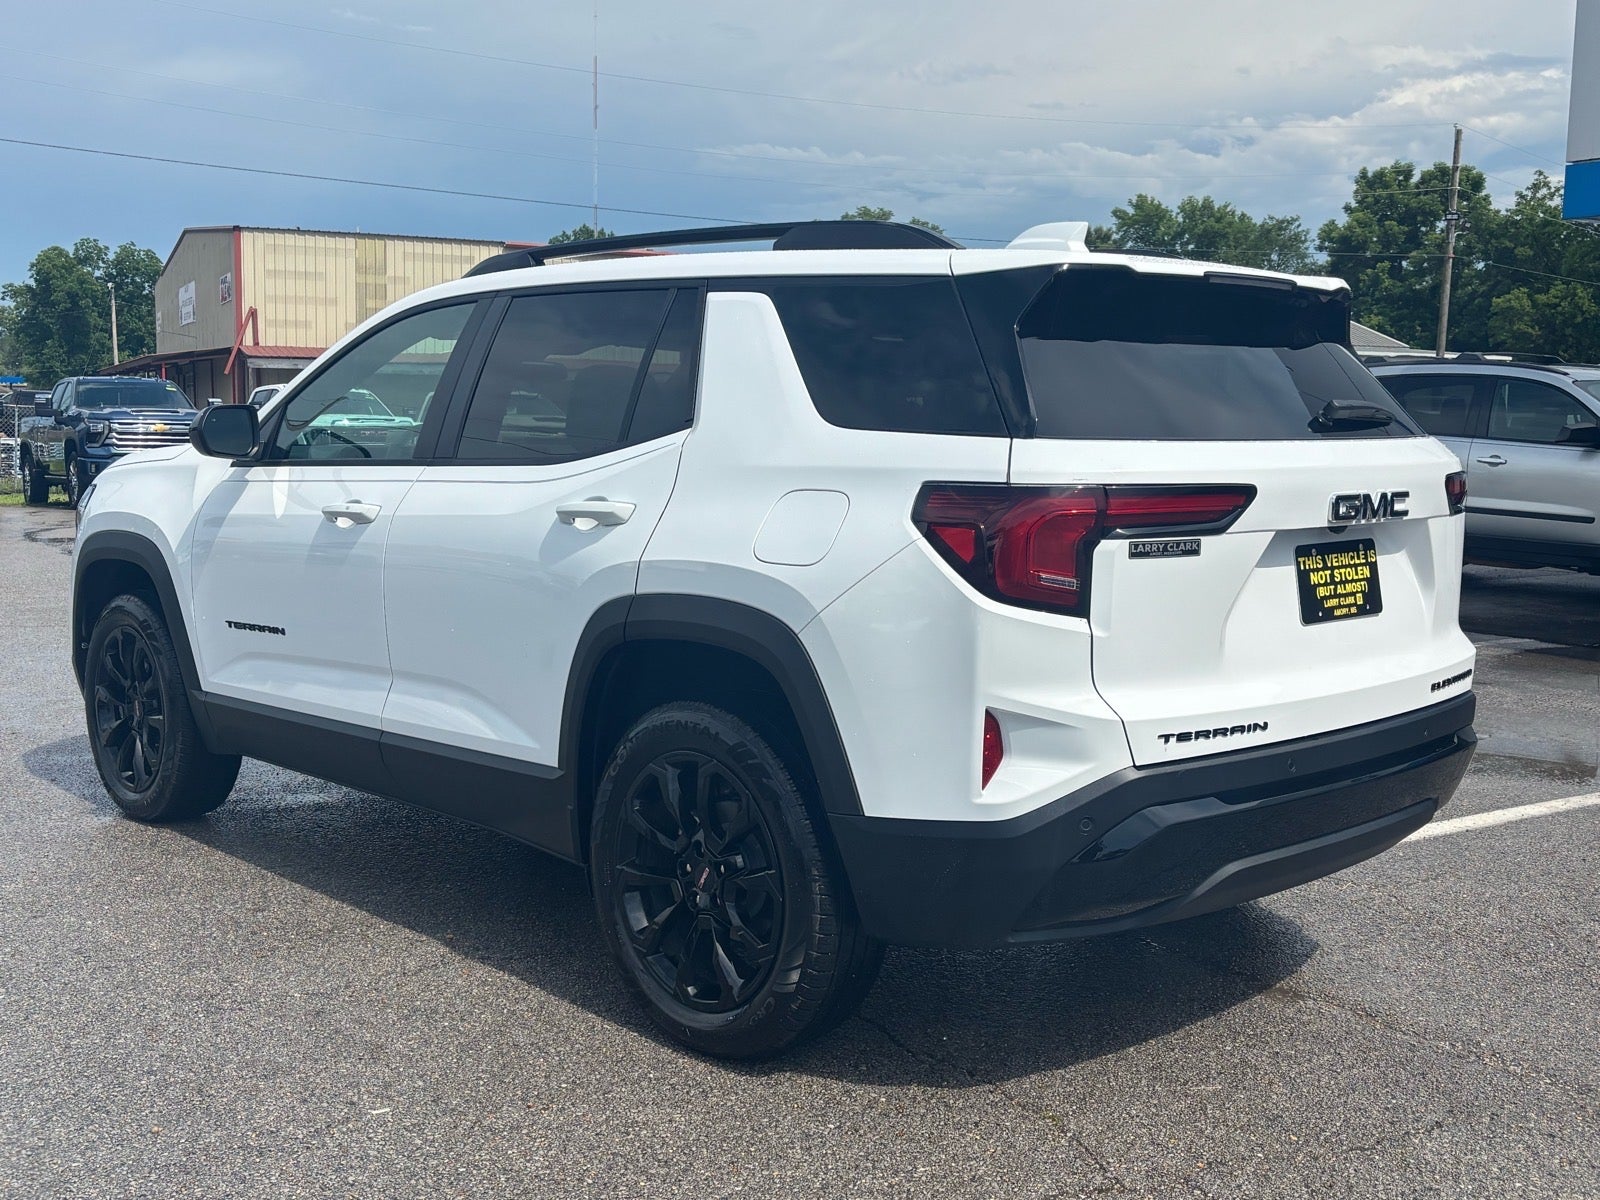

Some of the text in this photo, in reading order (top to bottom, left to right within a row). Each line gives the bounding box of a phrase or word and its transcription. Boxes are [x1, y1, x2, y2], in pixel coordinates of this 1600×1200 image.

[1329, 491, 1410, 523] GMC
[1131, 543, 1165, 553] LARRY
[1167, 541, 1199, 551] CLARK
[1297, 549, 1376, 570] THIS VEHICLE IS
[1310, 565, 1371, 585] NOT STOLEN
[1316, 581, 1368, 599] (BUT ALMOST)
[1323, 596, 1355, 608] LARRY CLARK
[224, 620, 286, 636] TERRAIN
[1157, 721, 1269, 745] TERRAIN
